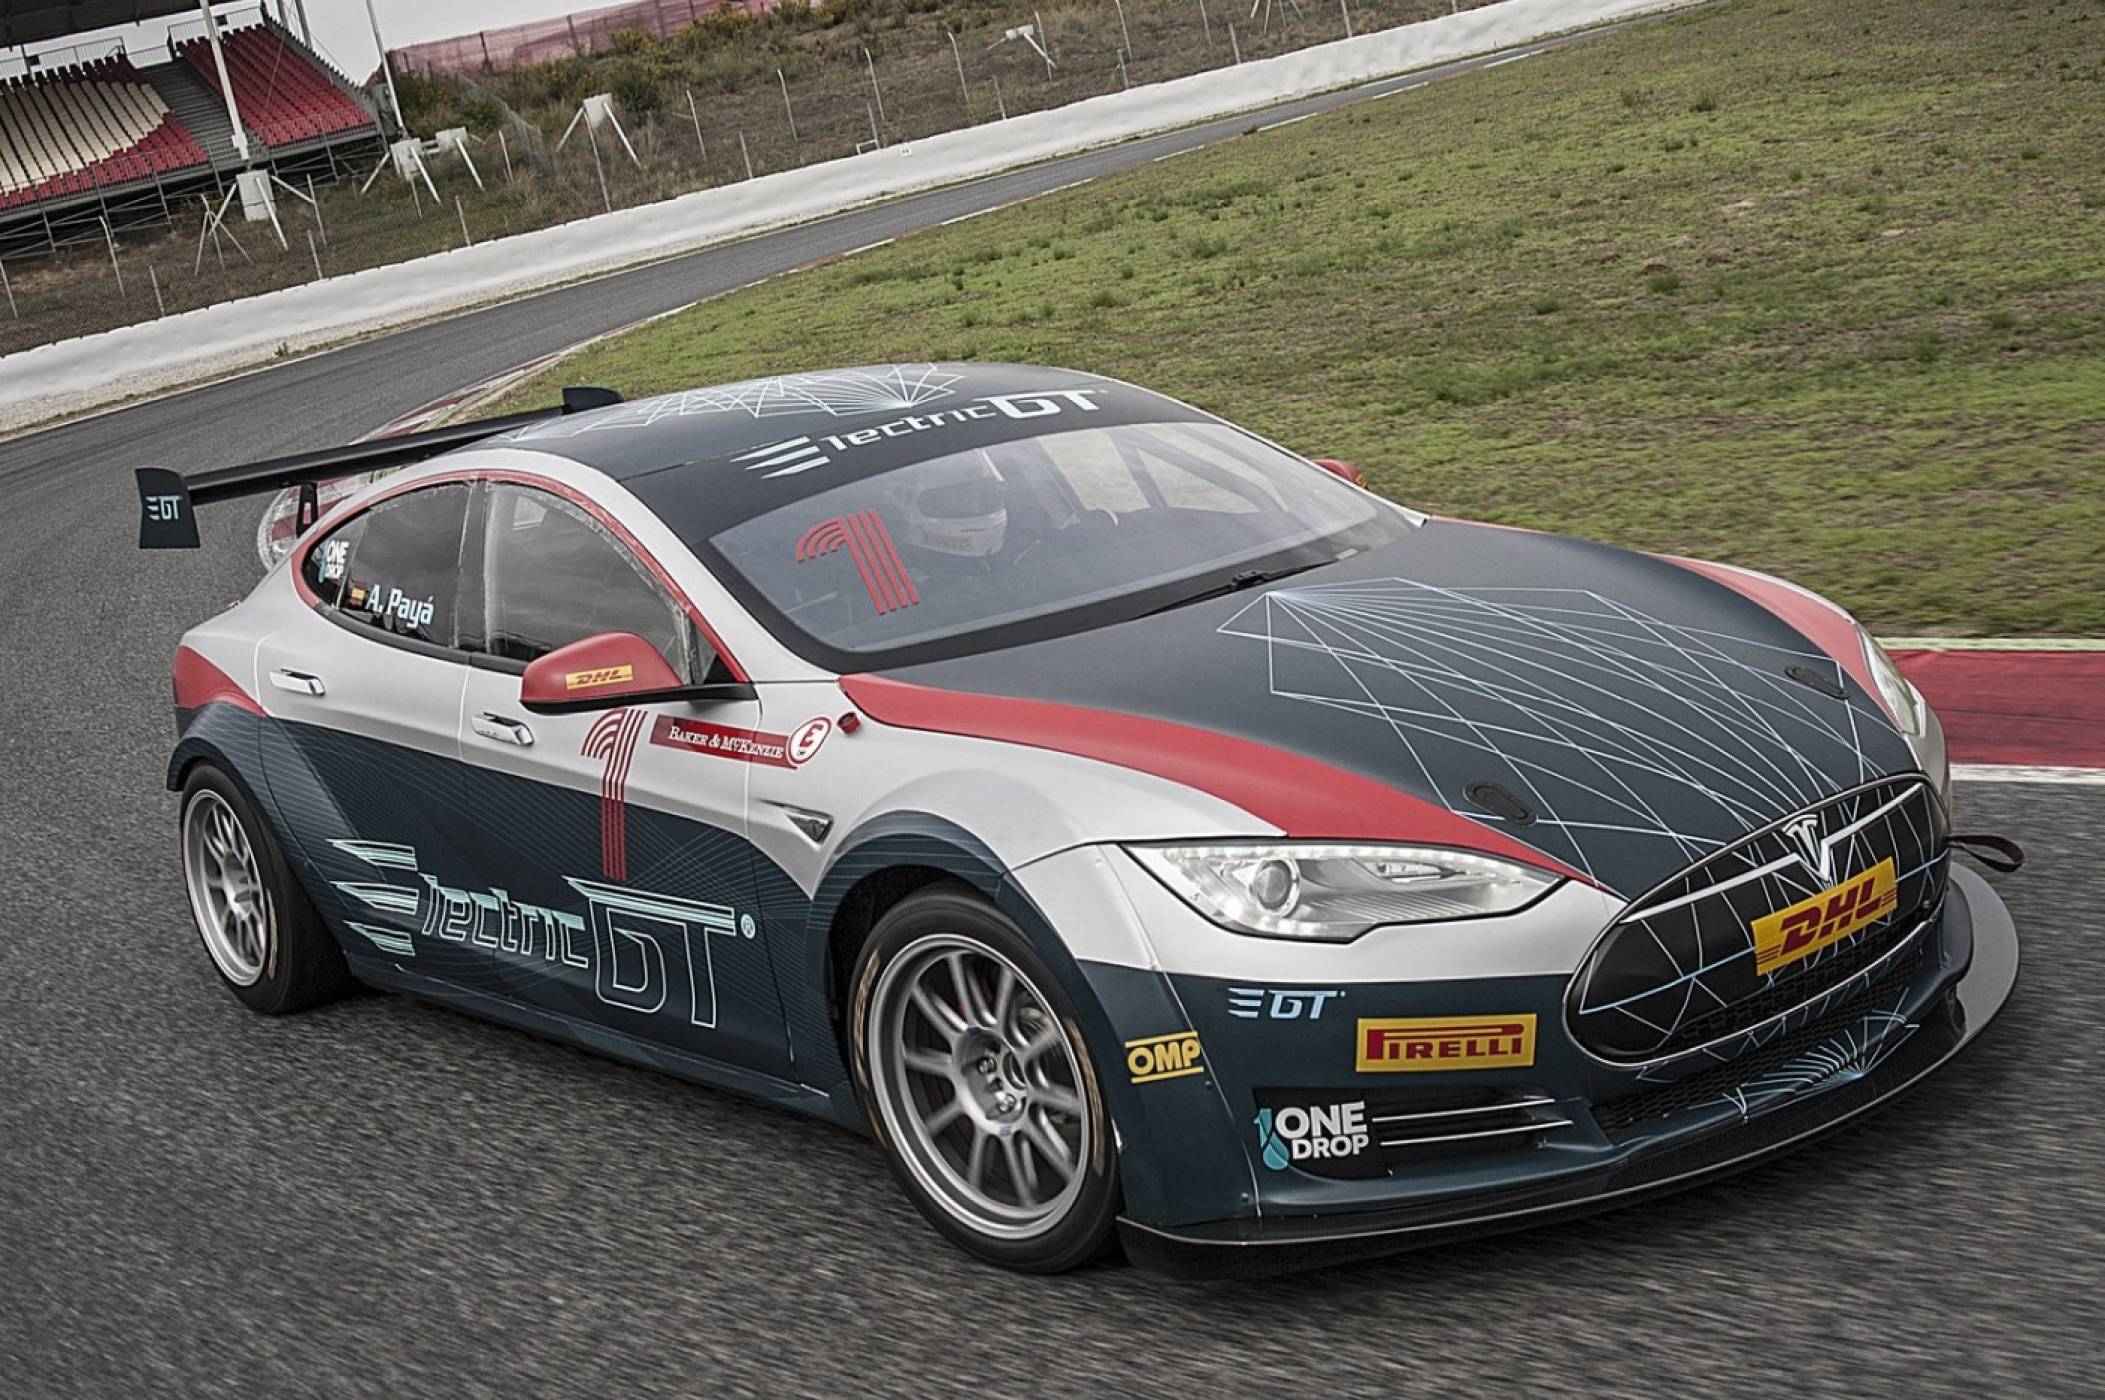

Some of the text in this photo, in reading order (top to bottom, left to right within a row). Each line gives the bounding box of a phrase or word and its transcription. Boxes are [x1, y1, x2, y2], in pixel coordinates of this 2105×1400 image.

[326, 539, 350, 564] ONE
[365, 584, 434, 628] A. Payá
[576, 669, 623, 685] DHL
[668, 725, 709, 746] BAKER
[710, 733, 721, 748] &
[1778, 876, 1883, 956] DHL
[1127, 1039, 1201, 1076] OMP
[1366, 1023, 1525, 1060] PIRELLI
[1275, 1101, 1369, 1139] ONE
[1292, 1134, 1369, 1161] DROP
